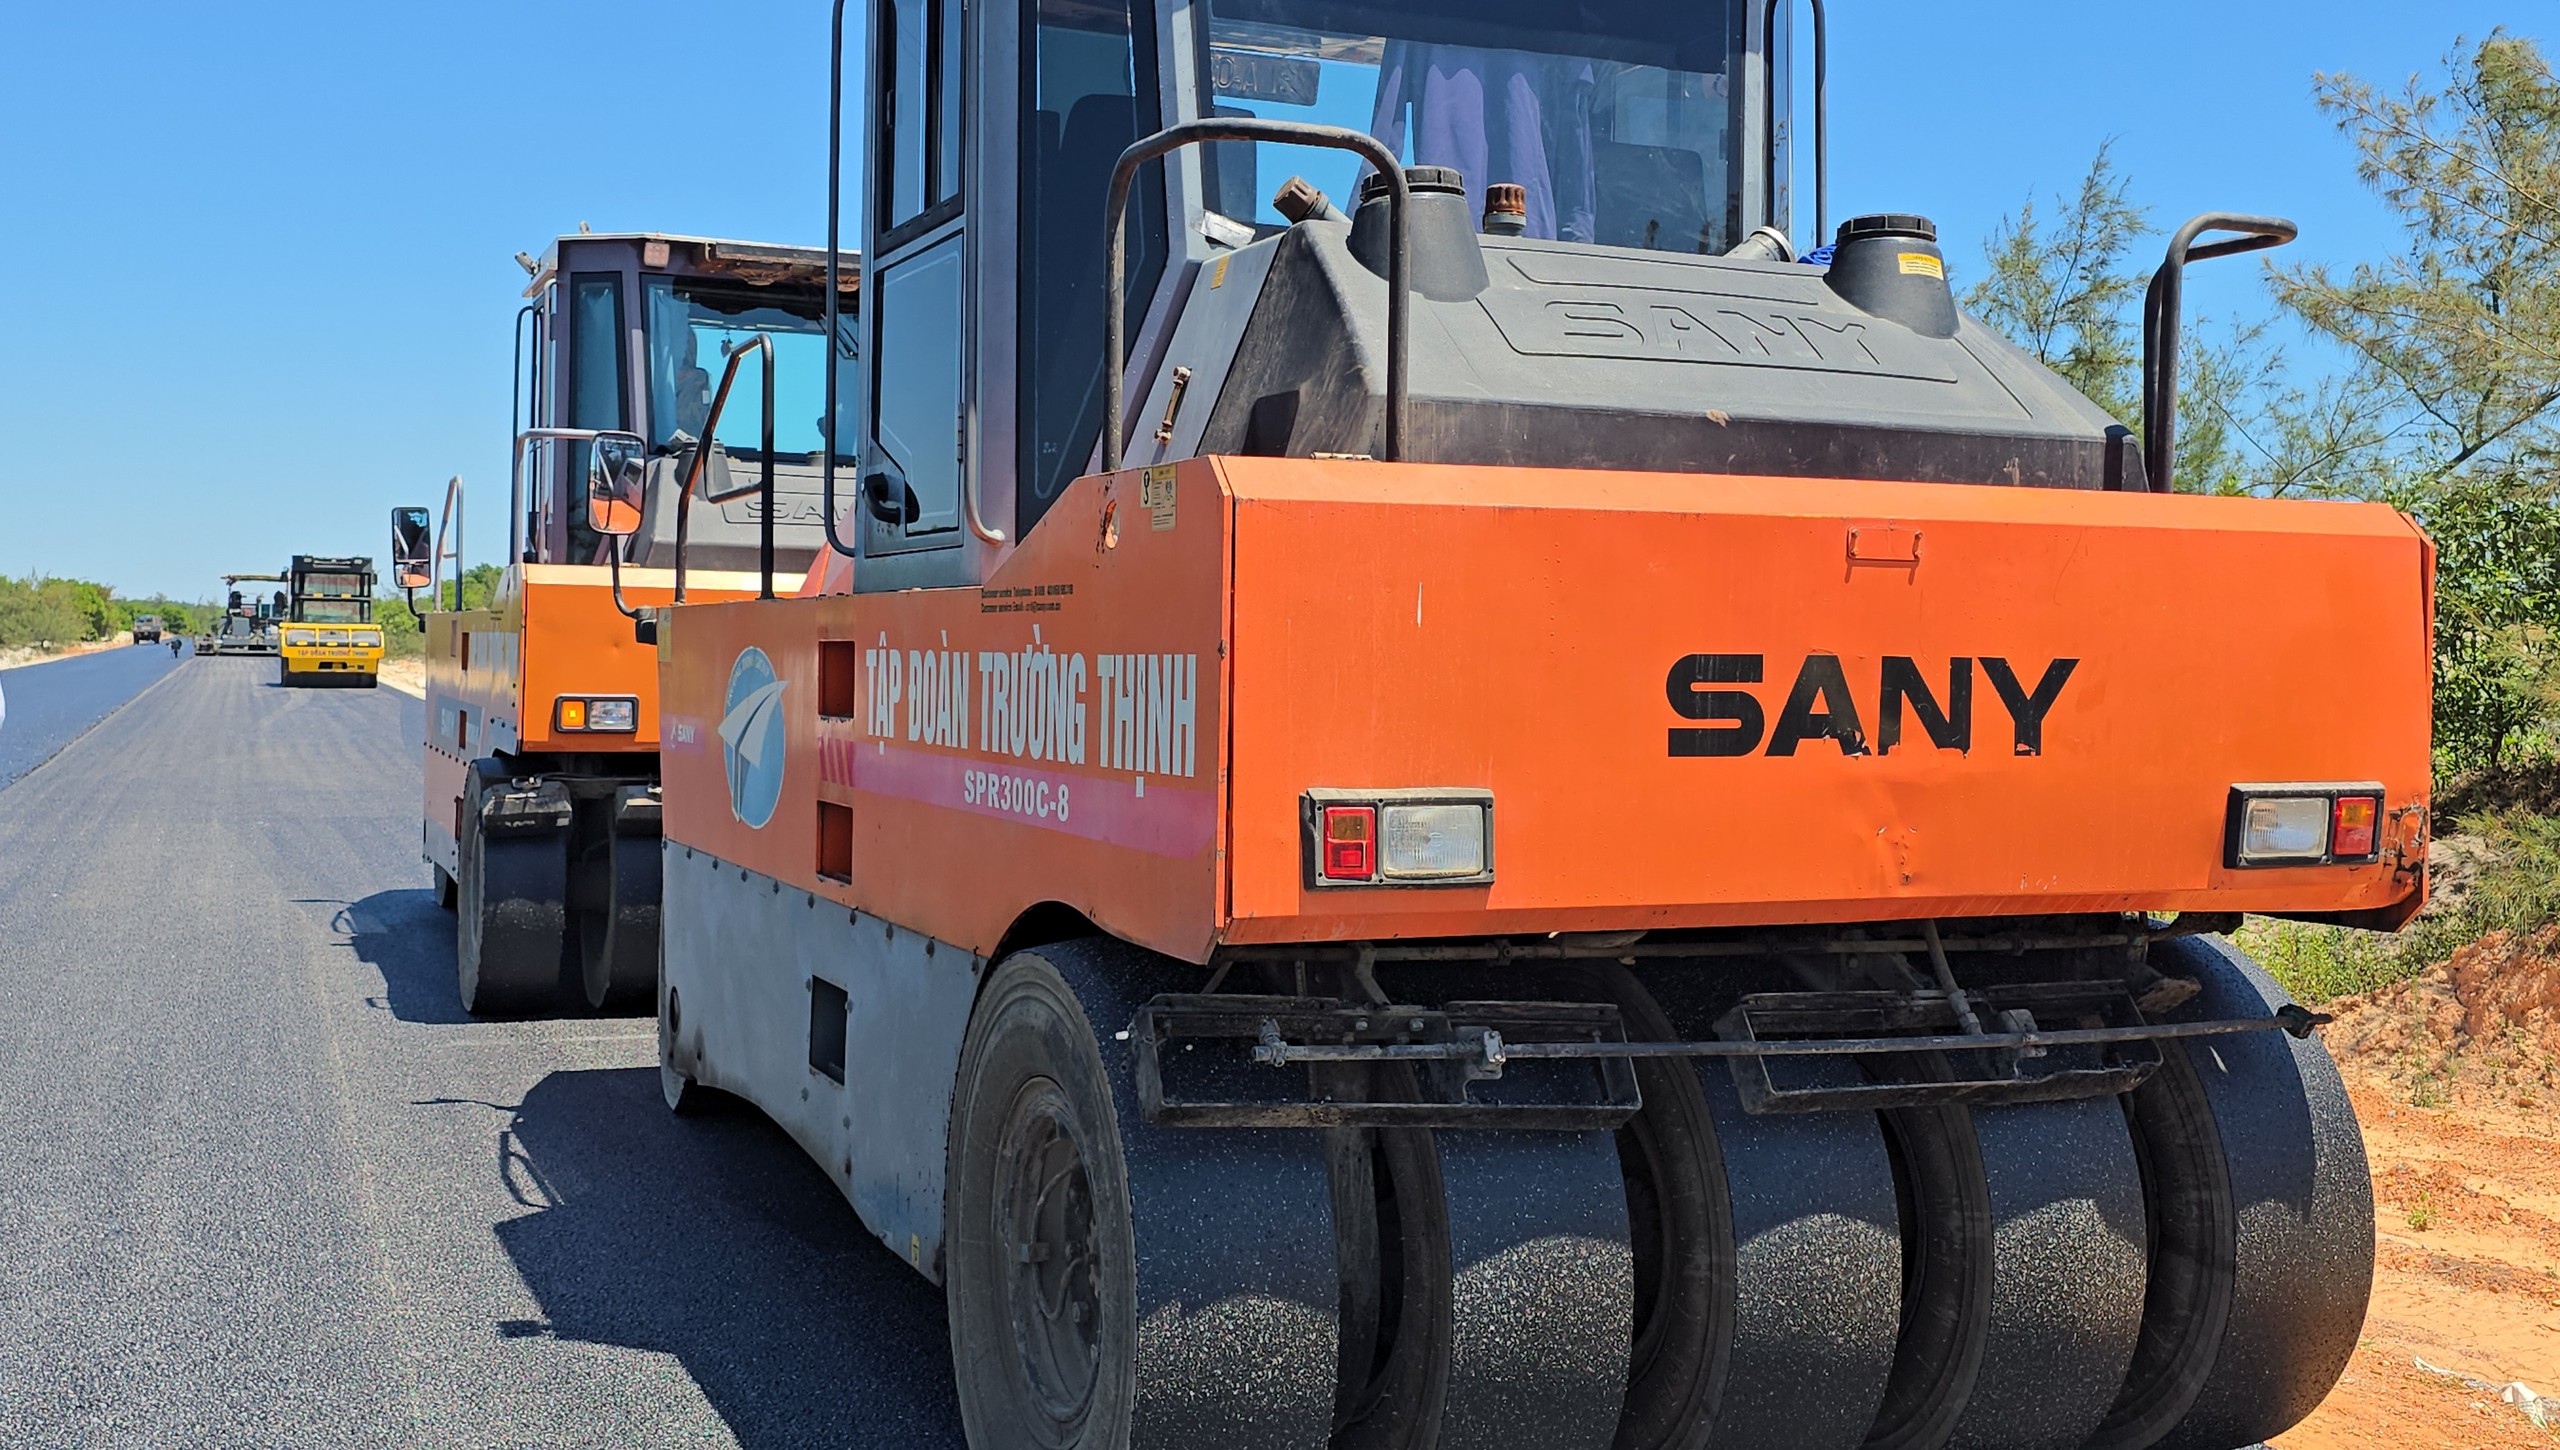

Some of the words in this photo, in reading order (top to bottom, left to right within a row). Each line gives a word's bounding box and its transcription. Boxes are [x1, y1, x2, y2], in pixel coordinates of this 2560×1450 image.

[1544, 300, 1881, 366] SANY
[865, 630, 903, 756] TẬP
[907, 629, 970, 750] ĐOÀN
[978, 623, 1087, 765] TRƯỜNG
[1097, 653, 1197, 798] THỊNH
[1665, 653, 2081, 759] SANY
[963, 769, 1070, 823] SPR300C-8
